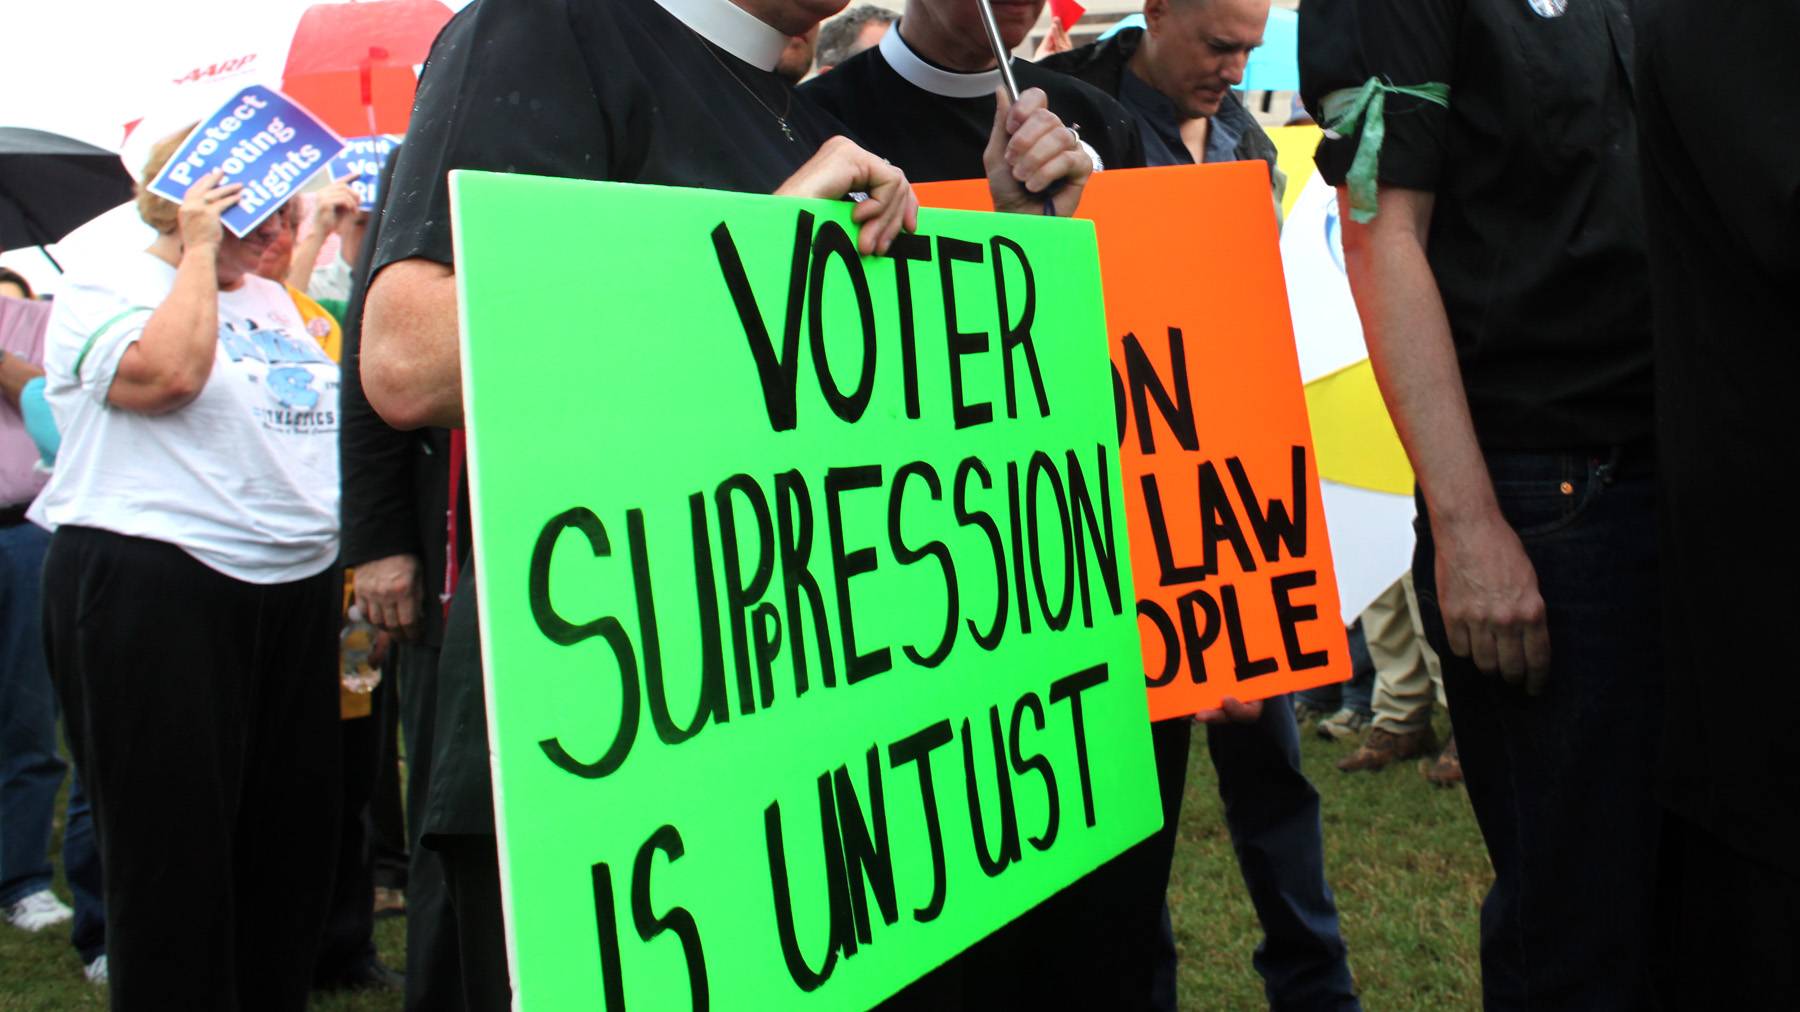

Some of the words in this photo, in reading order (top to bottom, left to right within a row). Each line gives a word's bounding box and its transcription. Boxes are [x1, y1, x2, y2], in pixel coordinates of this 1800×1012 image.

[168, 95, 267, 186] Protect
[218, 117, 296, 186] oting
[238, 144, 321, 214] Rights
[710, 209, 1050, 433] VOTER
[1140, 445, 1307, 587] LAW
[528, 442, 1123, 780] SUPPRESSION
[591, 824, 710, 1012] IS
[764, 662, 1109, 992] UNJUST
